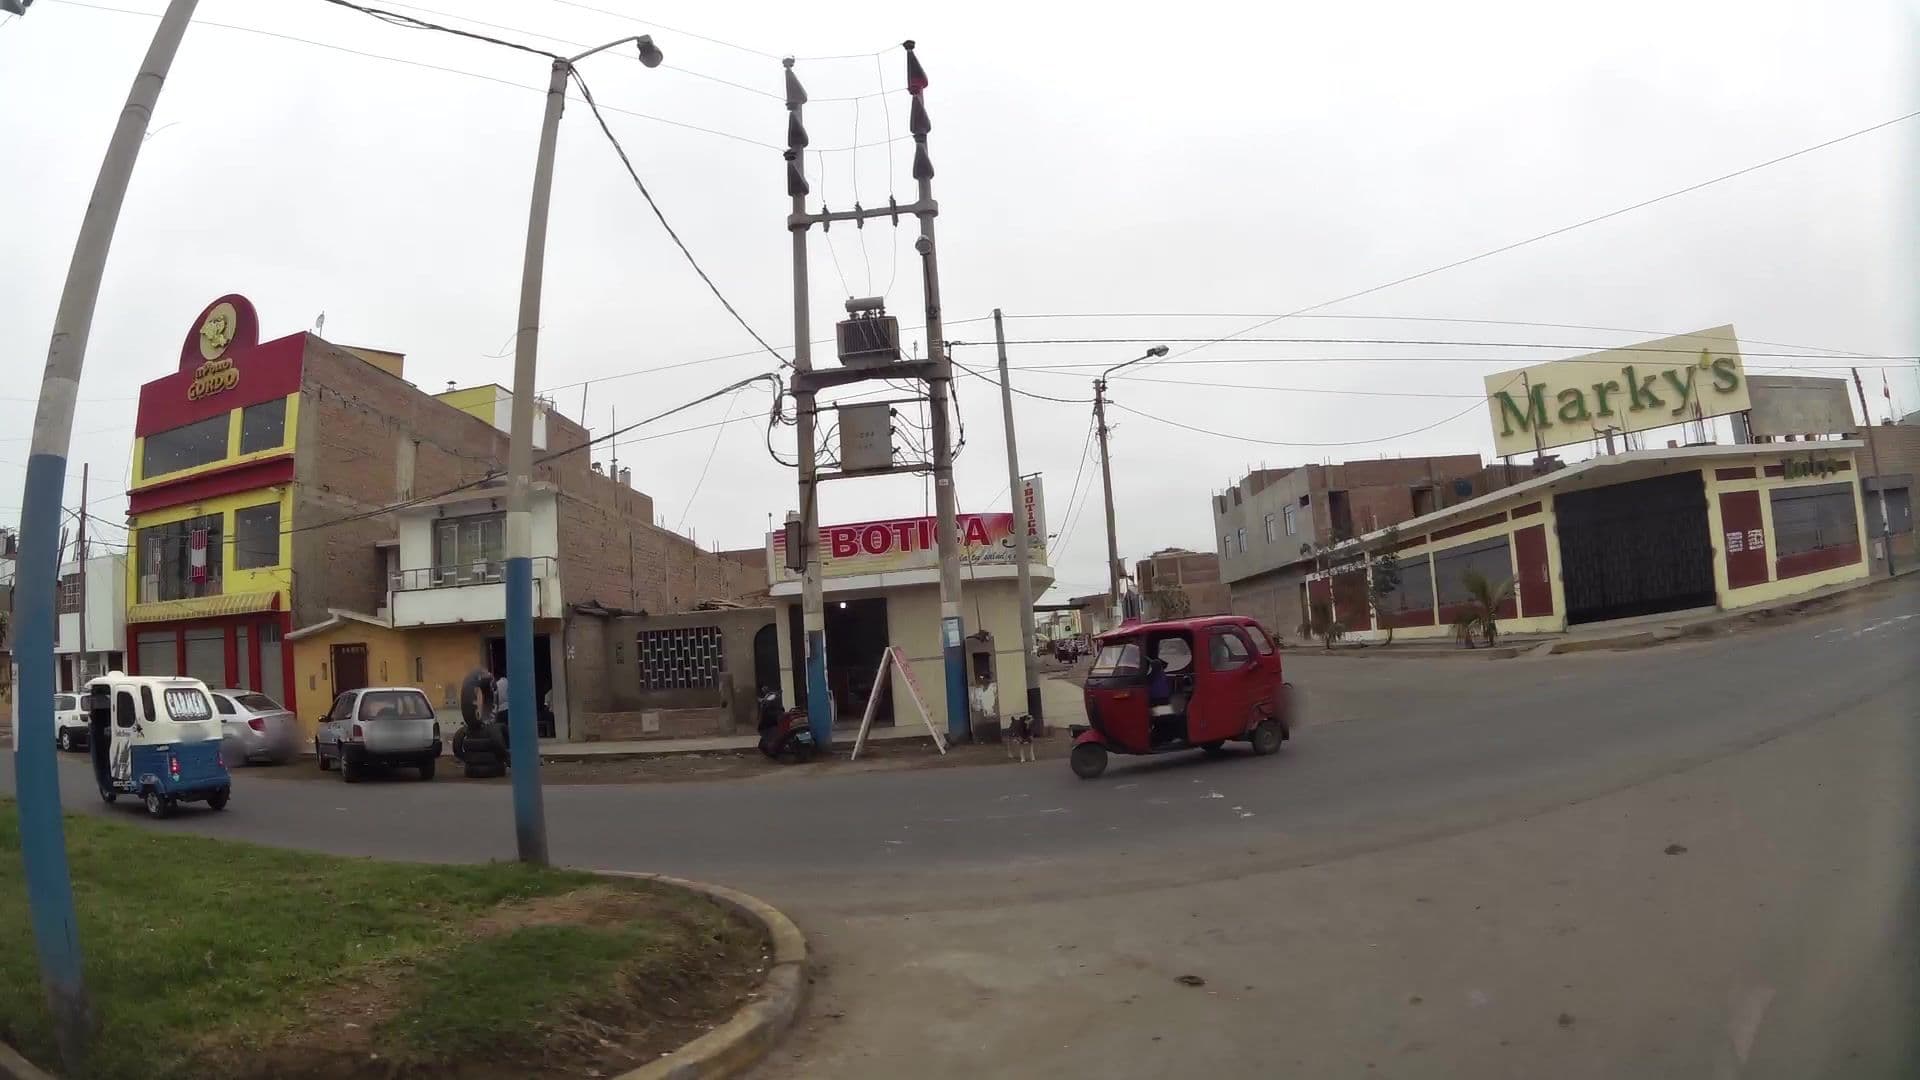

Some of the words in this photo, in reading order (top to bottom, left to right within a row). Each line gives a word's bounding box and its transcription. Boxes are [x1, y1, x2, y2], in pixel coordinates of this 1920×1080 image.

[188, 369, 239, 400] GORDO
[1494, 348, 1739, 437] Marky's
[1024, 488, 1037, 536] BOTICA
